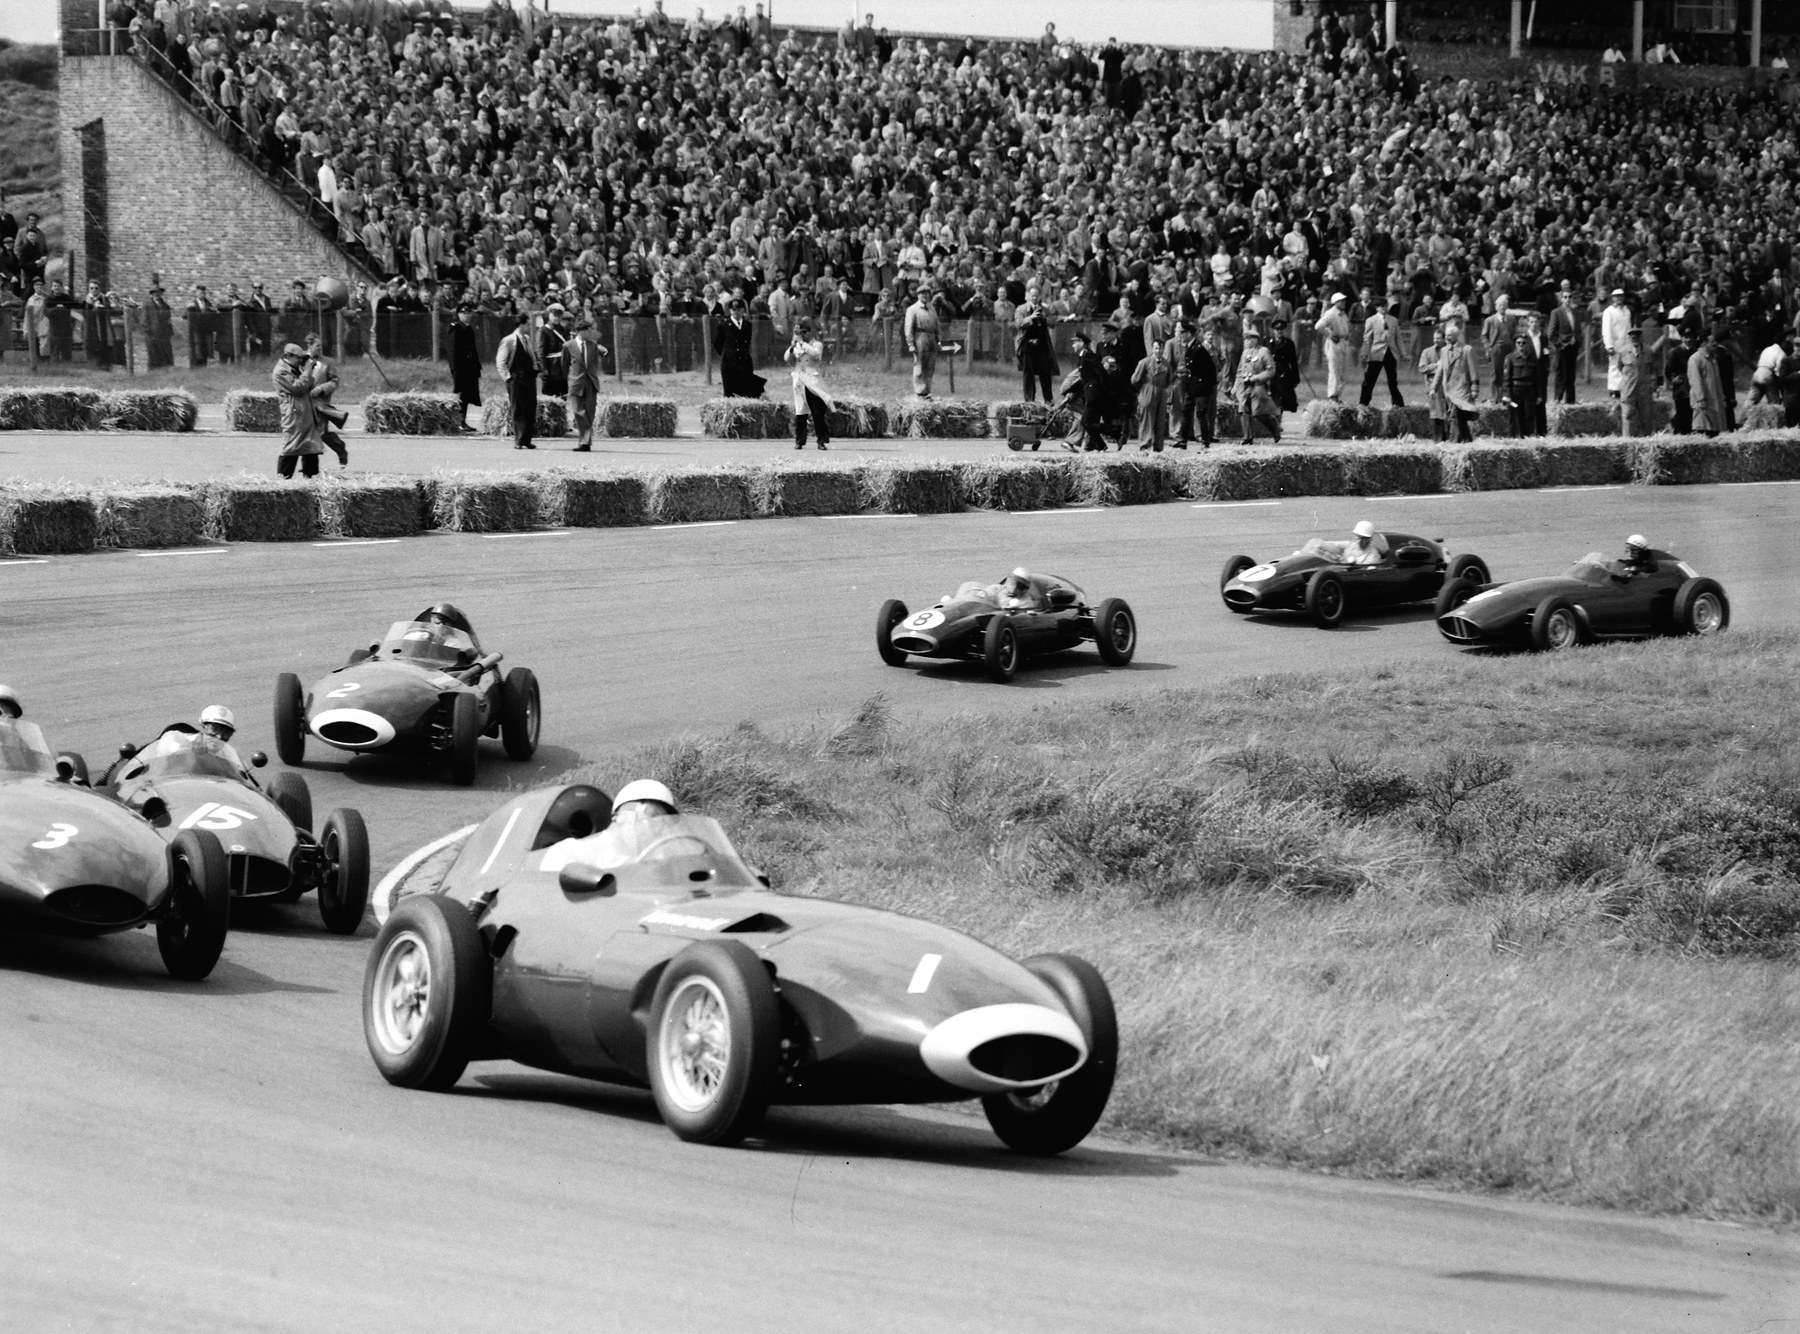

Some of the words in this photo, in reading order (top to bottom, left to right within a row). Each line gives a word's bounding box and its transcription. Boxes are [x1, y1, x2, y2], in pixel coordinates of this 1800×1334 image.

[1535, 63, 1588, 87] VAK
[913, 612, 933, 626] 8
[325, 682, 361, 698] 2
[178, 802, 258, 830] 15
[32, 822, 79, 850] 3
[907, 953, 943, 994] 1
